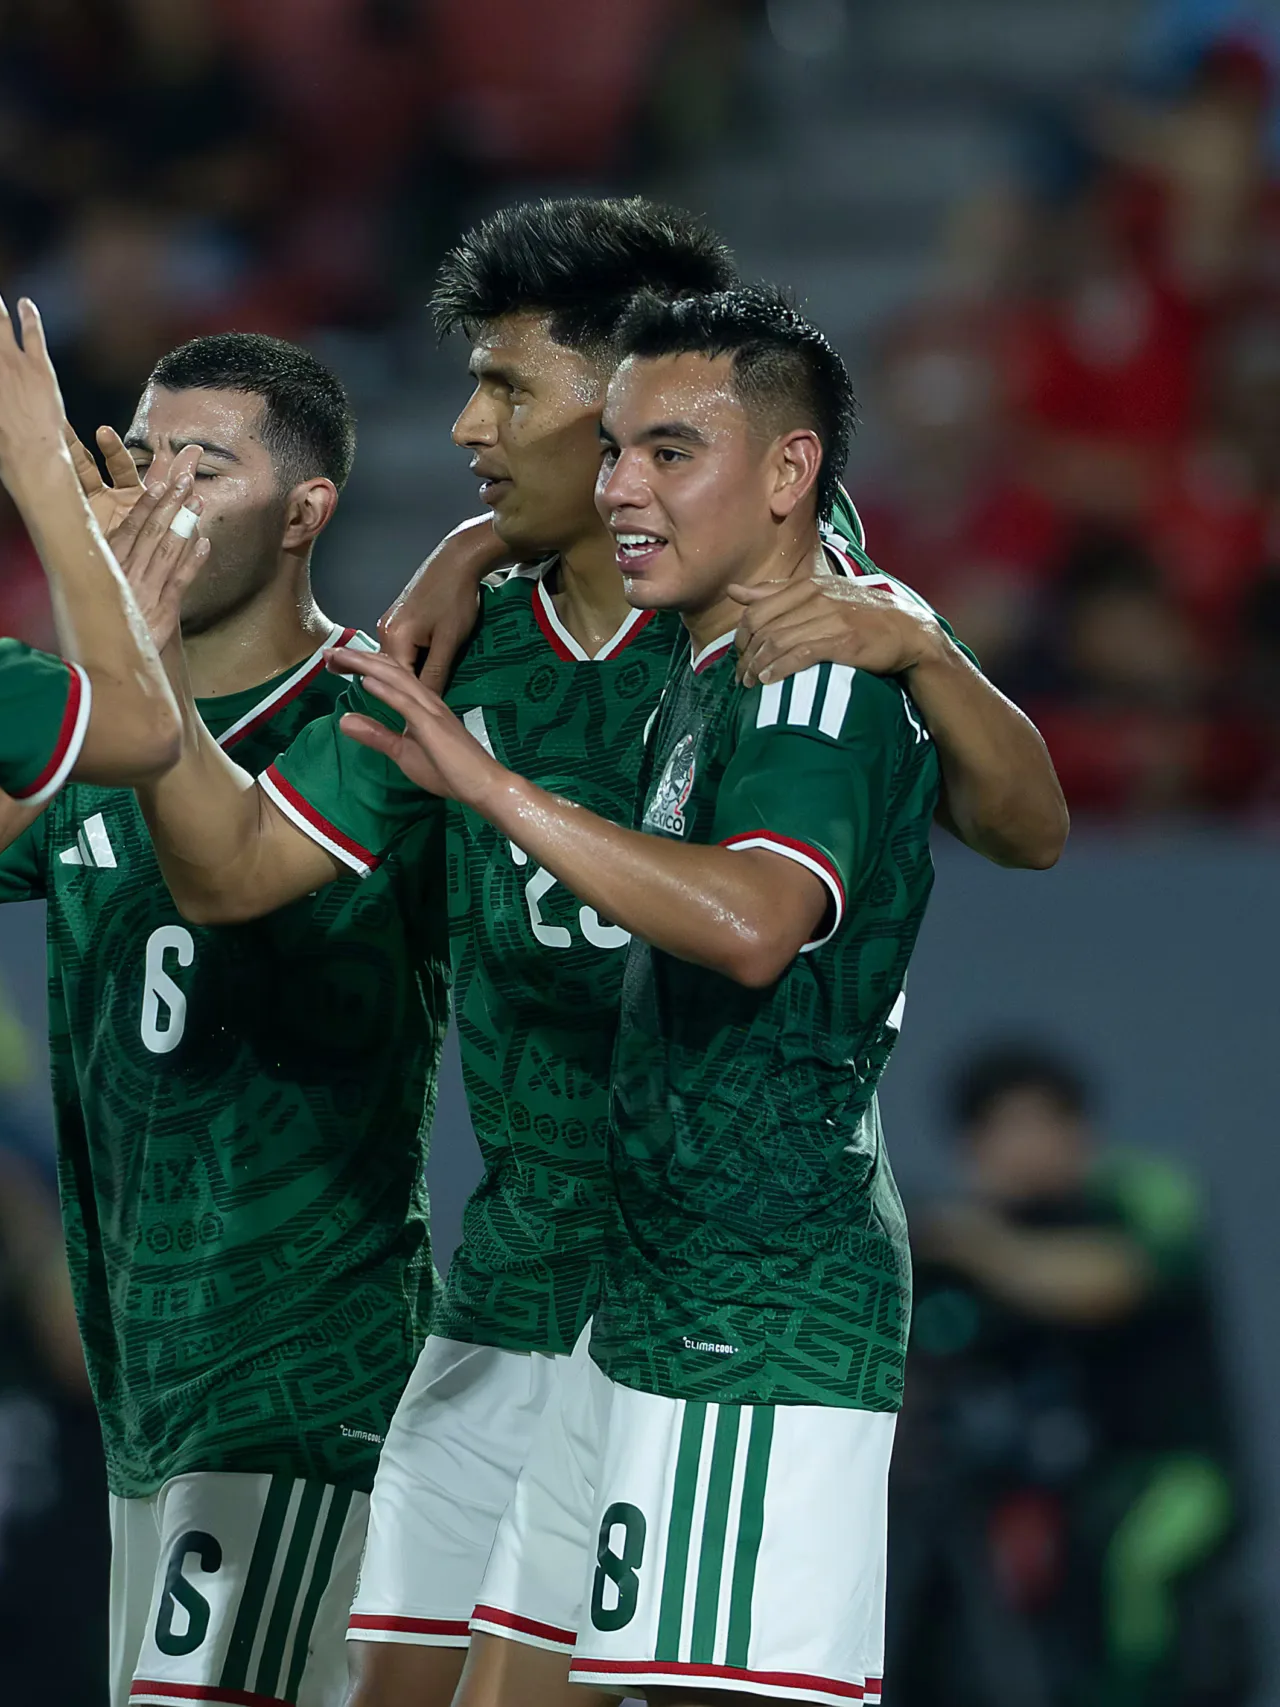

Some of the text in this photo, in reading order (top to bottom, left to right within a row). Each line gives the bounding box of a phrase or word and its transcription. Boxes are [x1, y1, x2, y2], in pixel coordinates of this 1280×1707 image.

[141, 925, 194, 1053] 6
[685, 1340, 734, 1354] CLIMACOOL
[155, 1530, 222, 1656] 6
[591, 1502, 647, 1632] 8
